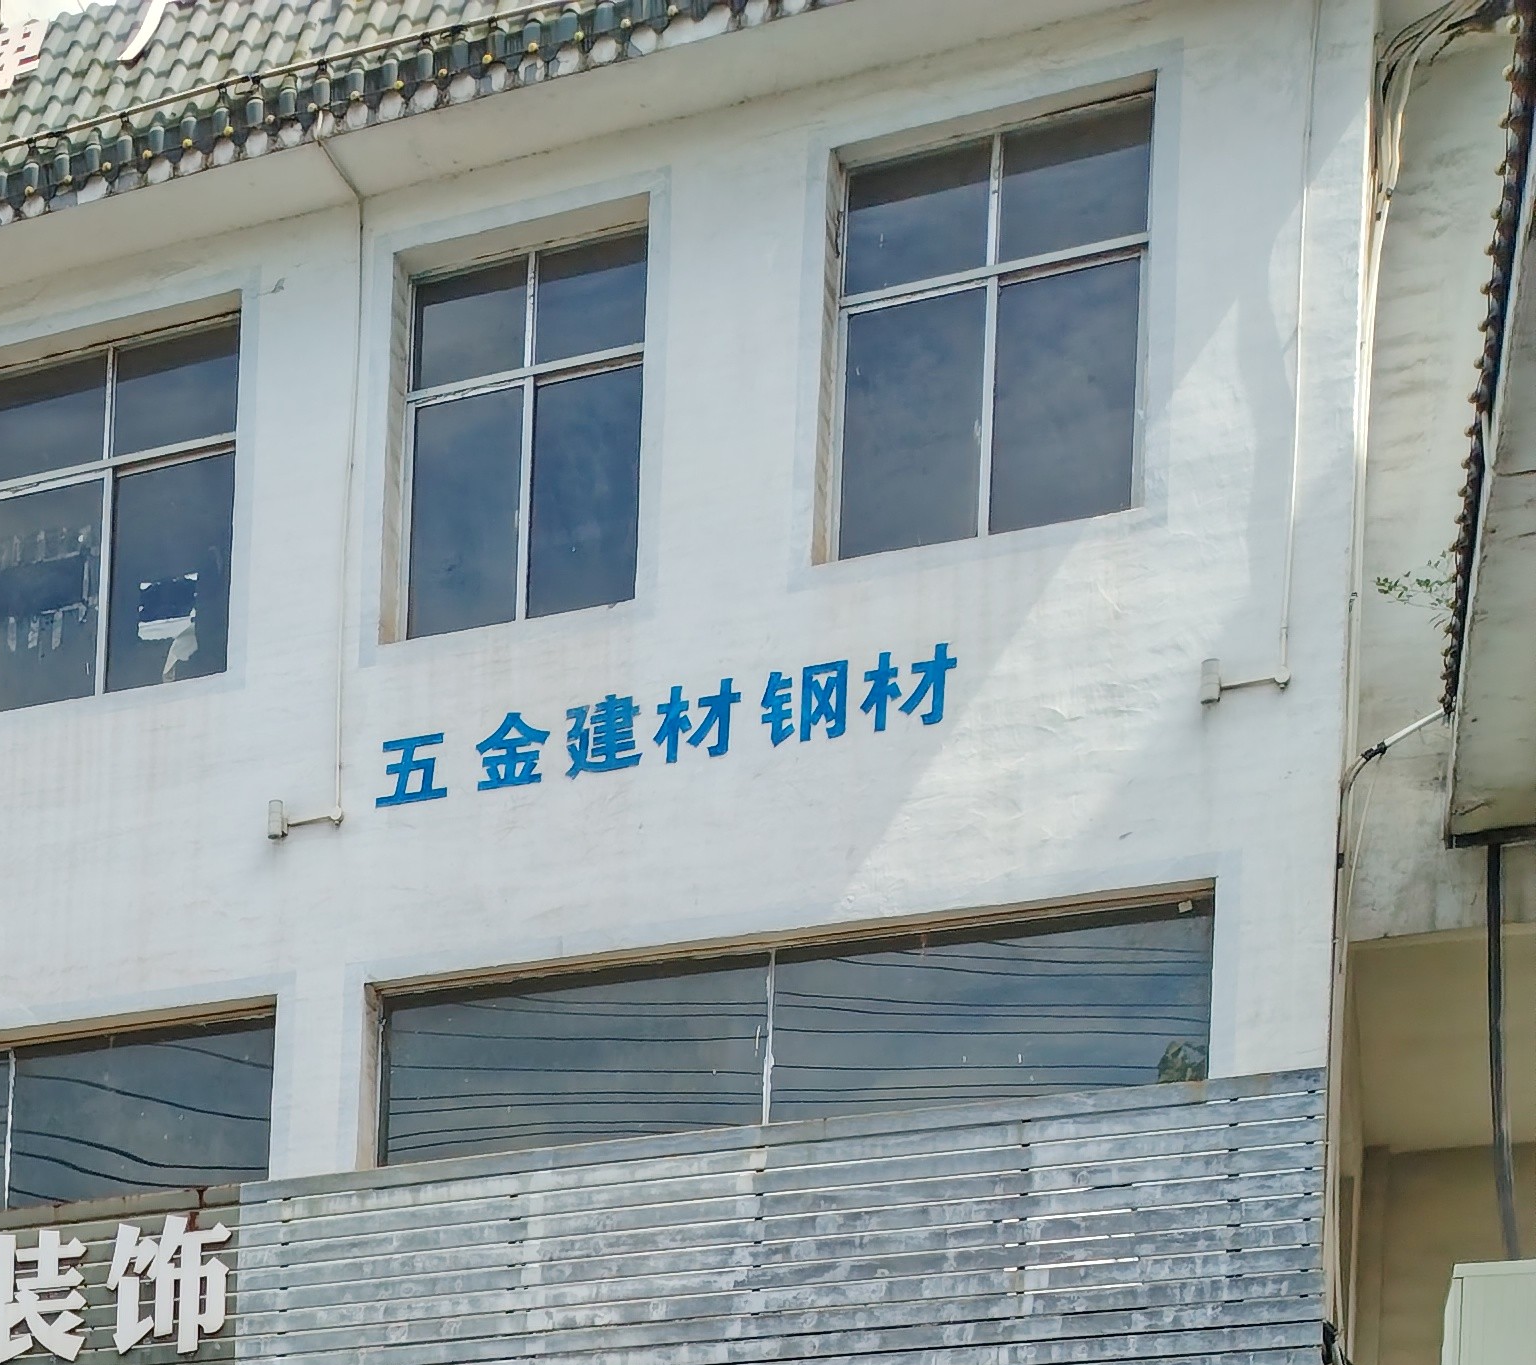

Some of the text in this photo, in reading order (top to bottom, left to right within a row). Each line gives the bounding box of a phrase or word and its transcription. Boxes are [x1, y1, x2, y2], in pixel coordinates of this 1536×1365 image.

[375, 642, 958, 808] 五金建材钢材
